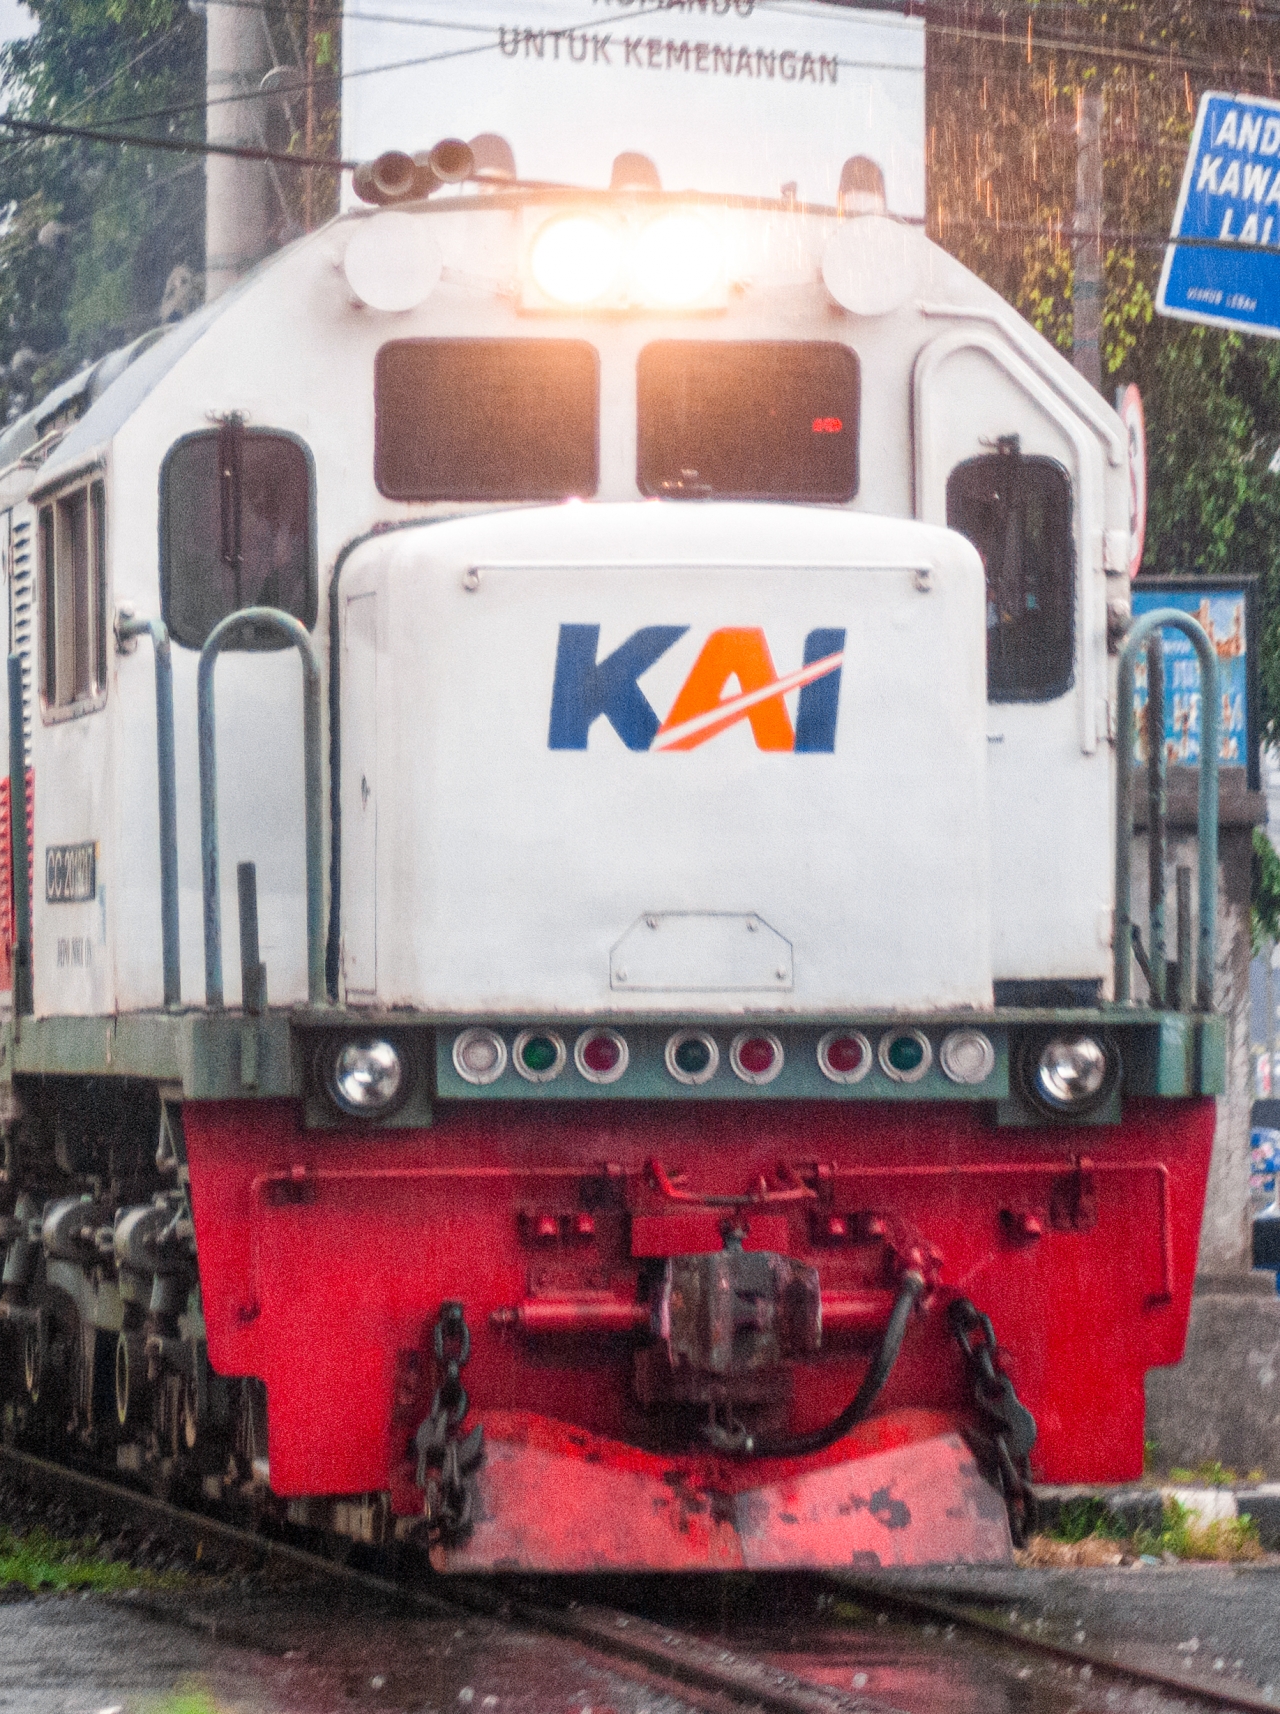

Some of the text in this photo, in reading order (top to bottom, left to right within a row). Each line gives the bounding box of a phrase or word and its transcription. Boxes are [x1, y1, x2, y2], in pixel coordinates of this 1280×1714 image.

[499, 24, 838, 85] UNTUK KEMENANGAN
[547, 622, 847, 754] KAI
[47, 849, 62, 898] CC
